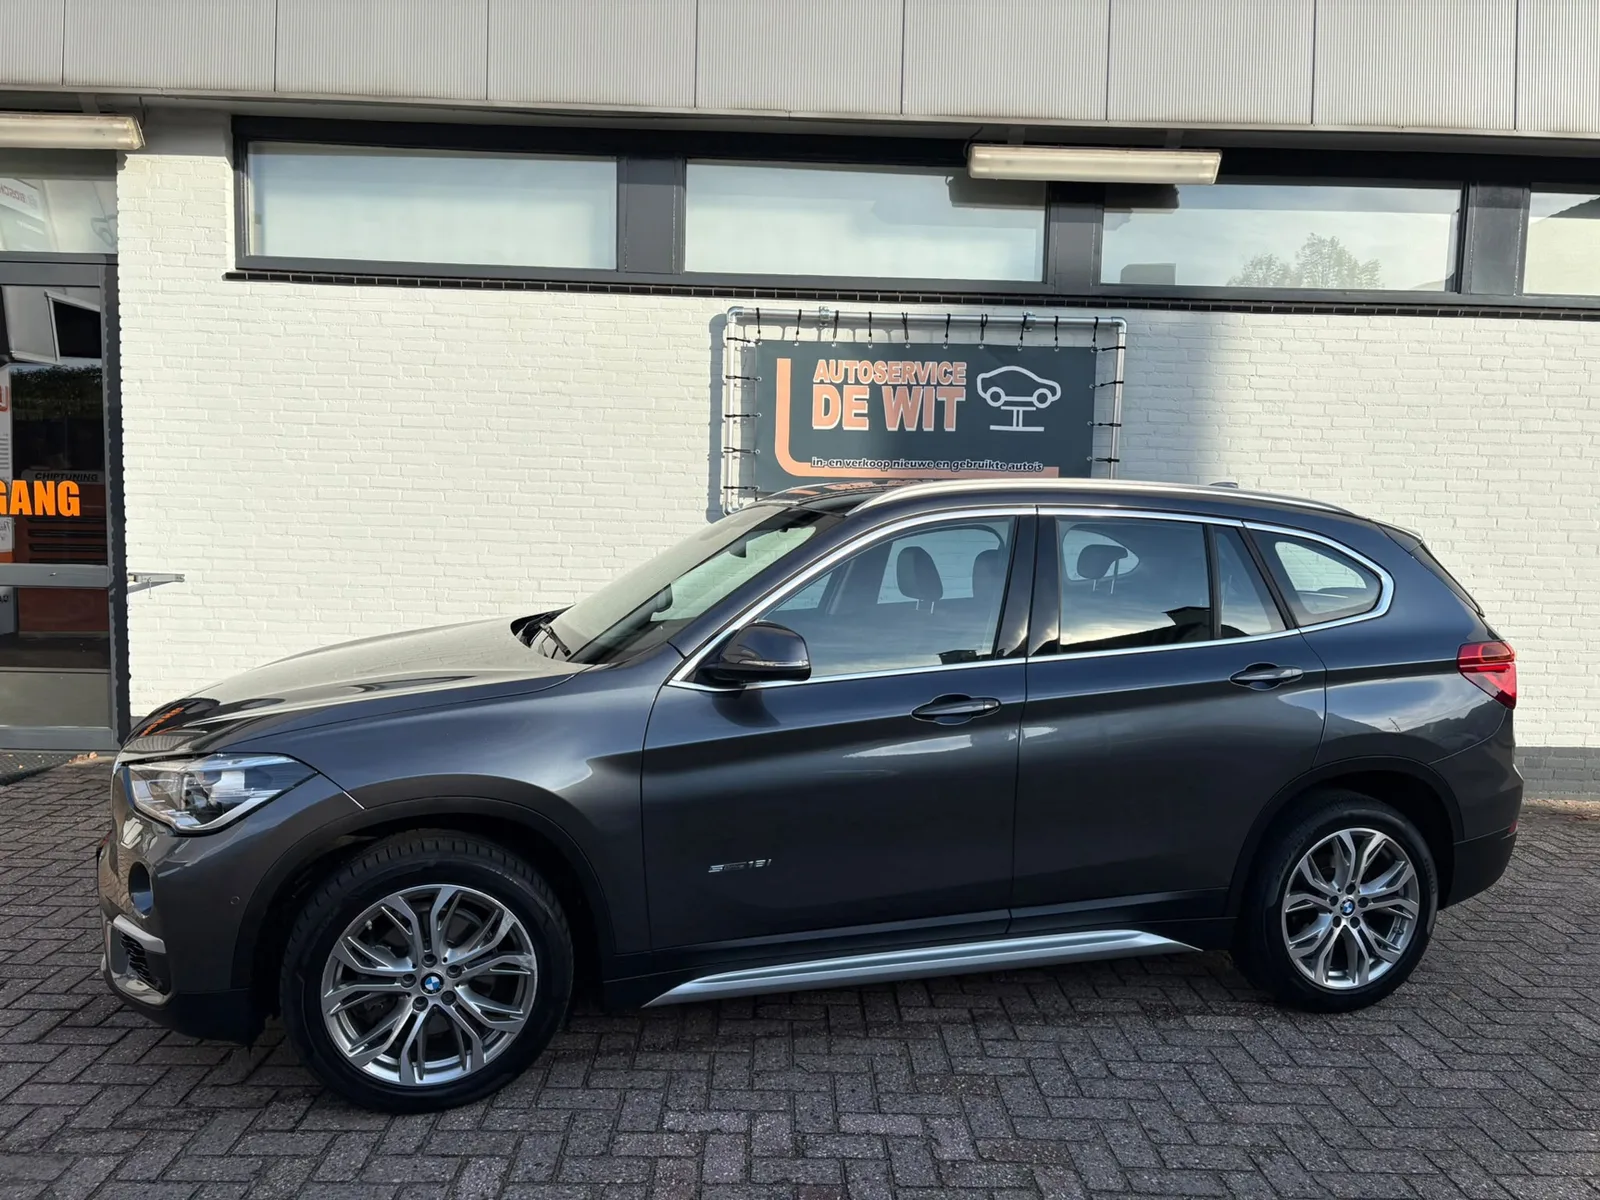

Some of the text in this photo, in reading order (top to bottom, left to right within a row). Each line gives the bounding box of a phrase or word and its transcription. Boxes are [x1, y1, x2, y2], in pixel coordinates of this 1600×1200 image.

[813, 359, 967, 385] AUTOSERVICE
[812, 384, 966, 432] DE WIT
[844, 457, 891, 472] verkoop
[892, 458, 934, 470] nieuwe
[935, 460, 950, 470] en
[951, 459, 1007, 472] gebruikte
[1007, 461, 1044, 472] auto's
[35, 472, 99, 481] CHIPTUNING
